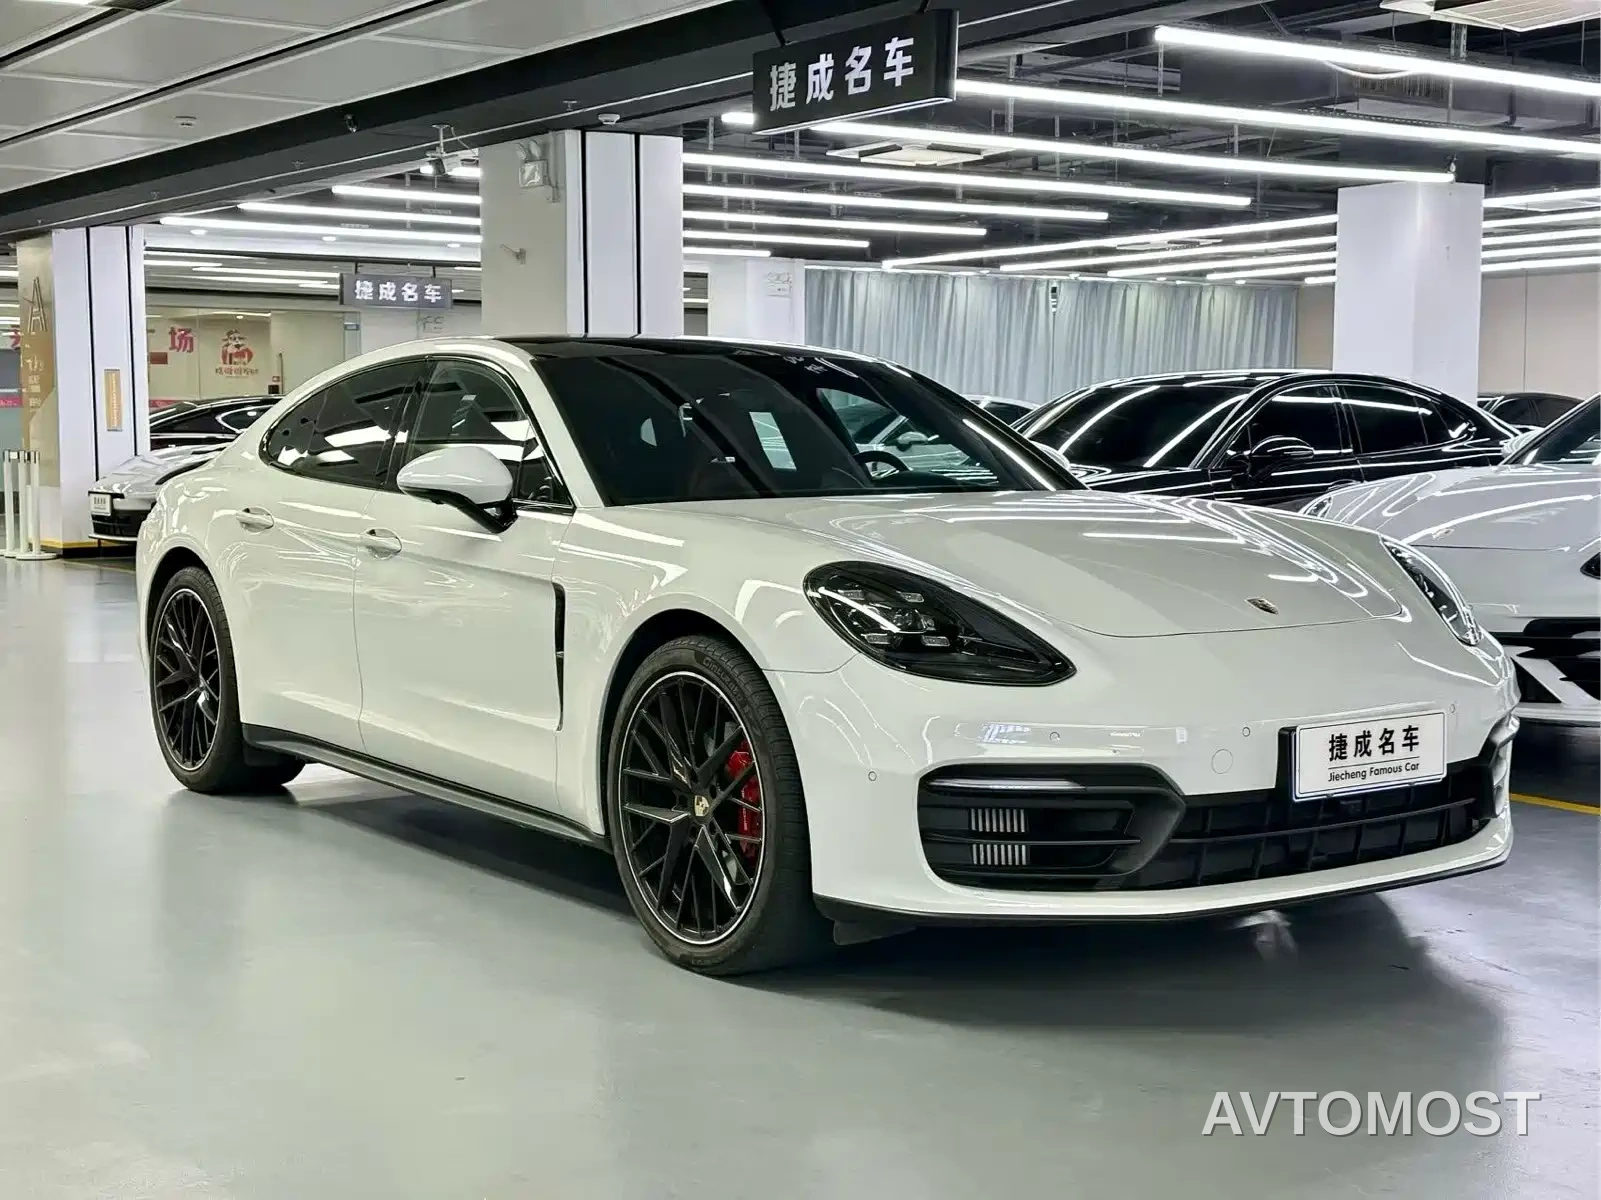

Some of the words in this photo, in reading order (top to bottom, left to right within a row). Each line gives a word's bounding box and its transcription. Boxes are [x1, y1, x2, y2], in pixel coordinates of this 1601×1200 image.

[769, 36, 914, 112] 捷成名车
[354, 280, 442, 303] 捷成名车
[1328, 725, 1420, 762] 捷成名车
[1327, 769, 1367, 782] Jiecheng
[1369, 765, 1403, 777] Famous
[1404, 762, 1420, 772] Car
